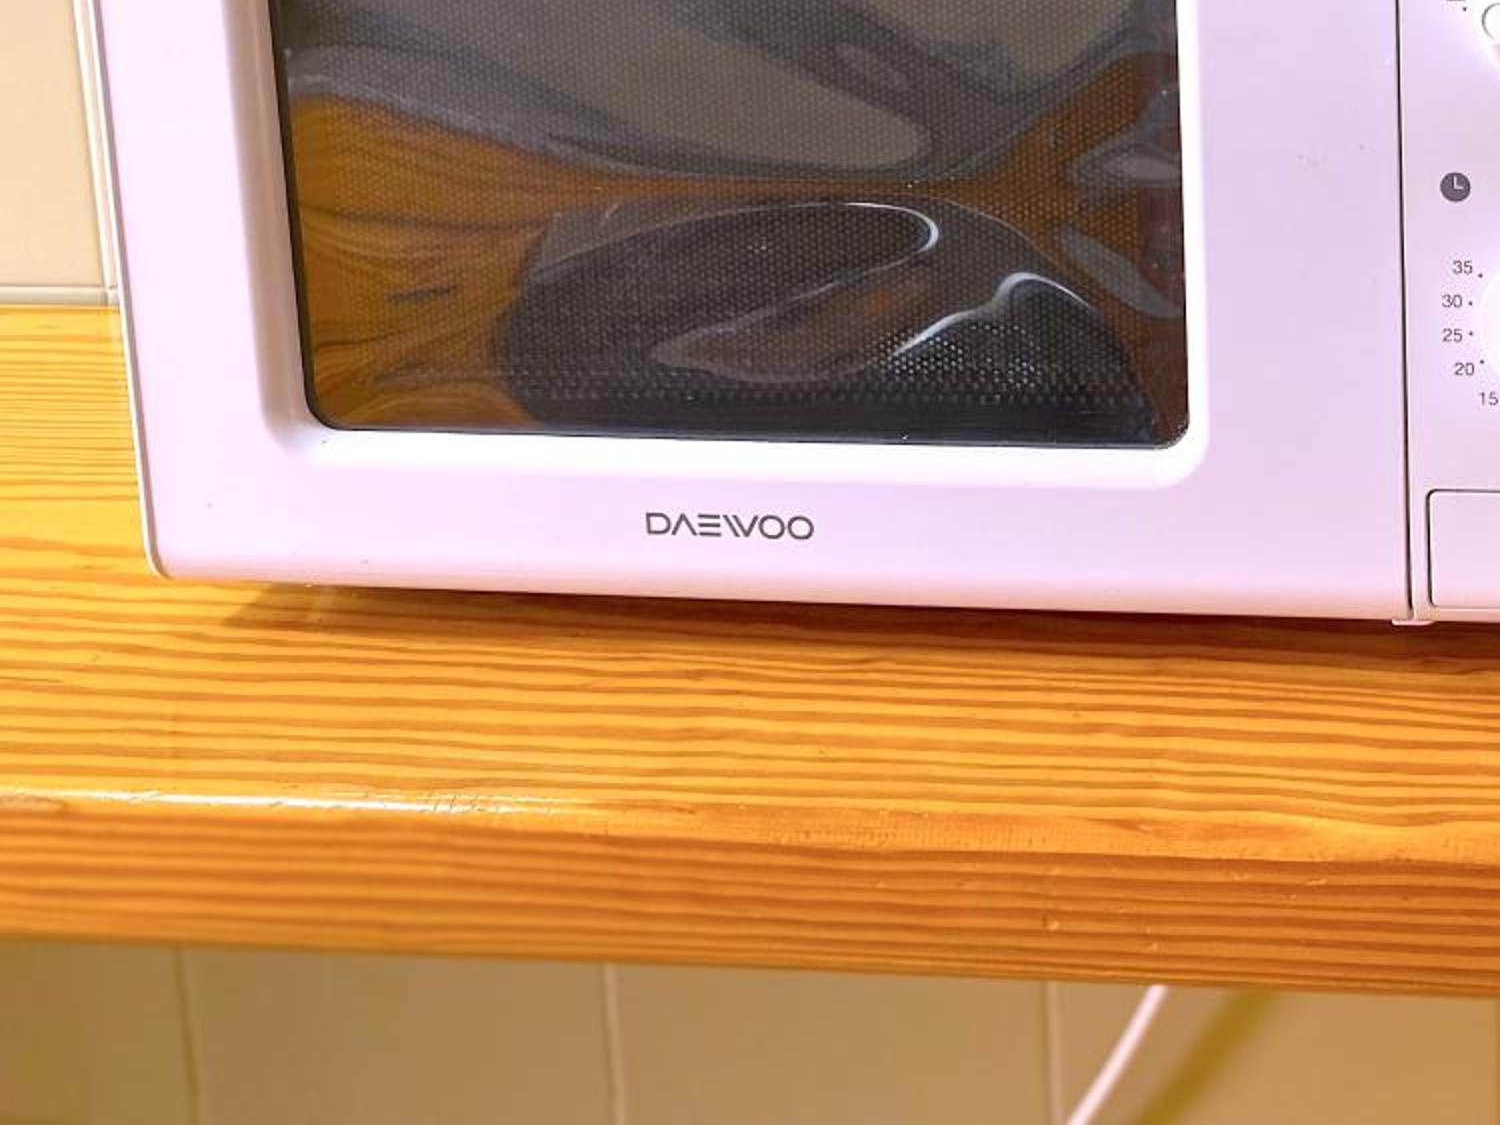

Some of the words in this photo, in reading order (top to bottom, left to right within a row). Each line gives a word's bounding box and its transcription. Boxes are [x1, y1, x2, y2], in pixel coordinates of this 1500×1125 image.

[1452, 260, 1473, 275] 35
[1441, 294, 1462, 308] 30
[1442, 328, 1463, 343] 25
[1454, 361, 1475, 376] 20
[1480, 391, 1499, 406] 15
[646, 512, 815, 540] DAEWOO
